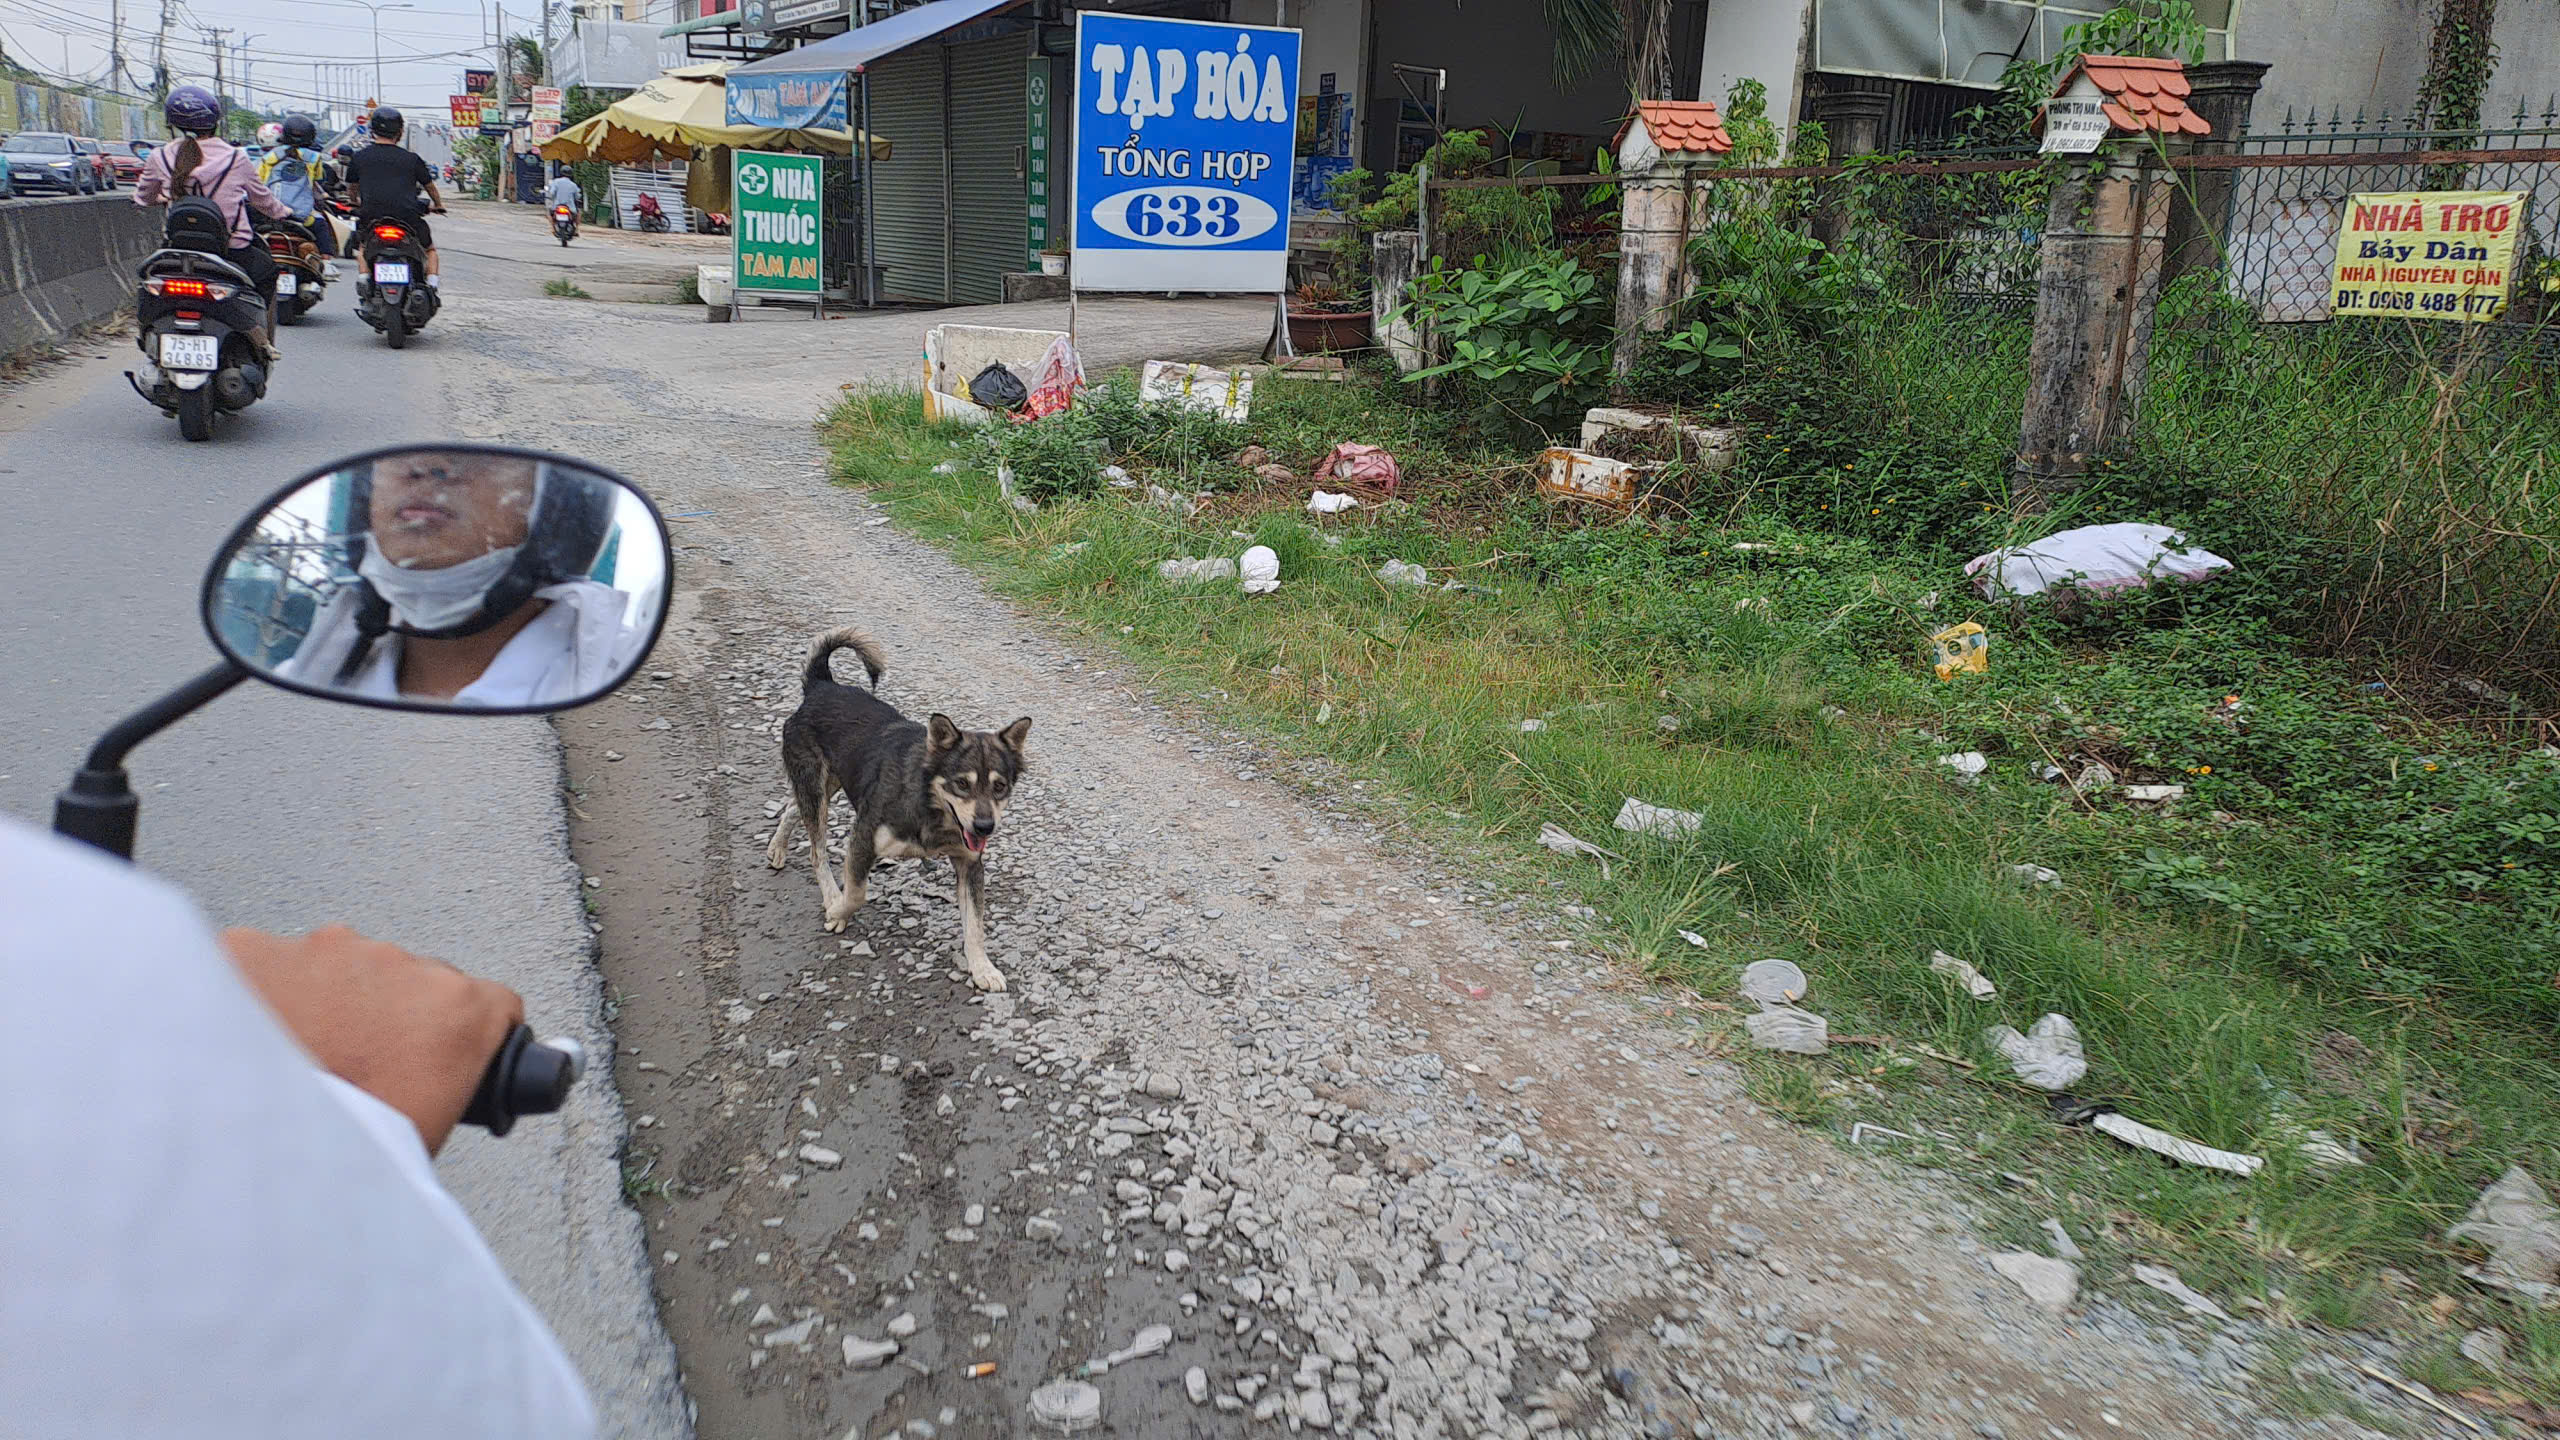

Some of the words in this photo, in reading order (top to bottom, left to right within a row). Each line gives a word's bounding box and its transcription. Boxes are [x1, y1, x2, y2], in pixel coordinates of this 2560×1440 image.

[1091, 43, 1187, 131] TẠP
[1193, 33, 1288, 123] HÓA
[1097, 134, 1190, 179] TỔNG
[1201, 150, 1272, 187] HỢP
[772, 164, 816, 201] NHÀ
[743, 203, 816, 246] THUỐC
[1126, 194, 1240, 237] 633
[2352, 198, 2424, 232] NHÀ
[2440, 204, 2511, 239] TRỌ
[741, 251, 785, 278] TÂM
[787, 256, 817, 279] AN
[2358, 239, 2416, 263] Bảy
[2424, 241, 2488, 261] Dân
[2337, 290, 2363, 309] ĐT:
[2420, 293, 2456, 312] 488
[170, 336, 208, 352] 75-H1
